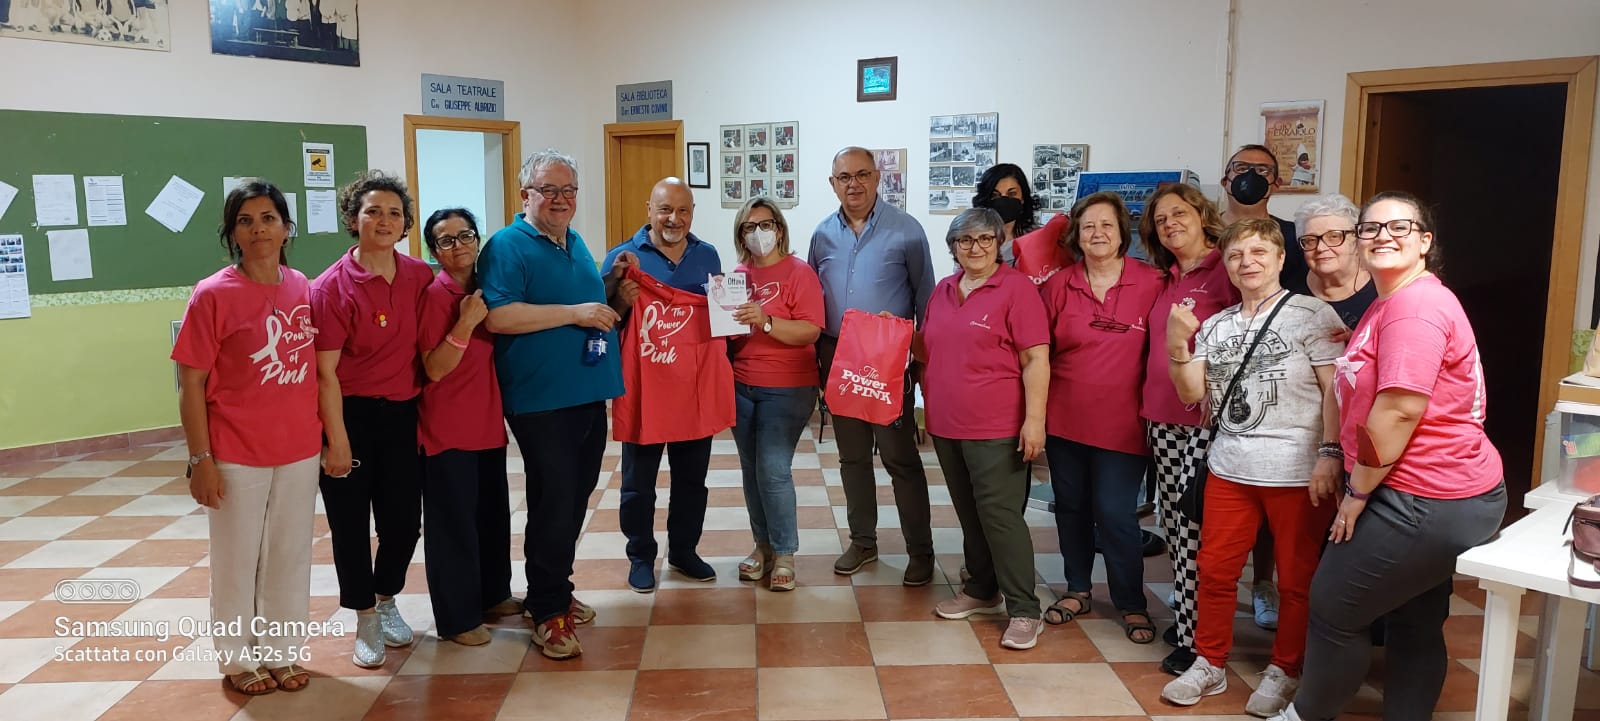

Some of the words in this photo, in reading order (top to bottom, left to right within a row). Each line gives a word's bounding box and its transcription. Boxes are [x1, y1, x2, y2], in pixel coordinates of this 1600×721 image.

[430, 82, 452, 94] SALA
[456, 84, 497, 98] TEATRALE
[620, 91, 635, 103] SALA
[636, 88, 668, 101] BIBLIOTECA
[444, 99, 472, 112] GIUSEPPE
[671, 307, 686, 318] The
[656, 319, 681, 331] Power
[661, 337, 669, 348] of
[289, 351, 300, 365] of
[640, 342, 679, 364] Pink
[260, 360, 309, 386] Pink
[841, 369, 888, 390] Power
[858, 365, 880, 380] The
[838, 381, 851, 396] of
[851, 383, 893, 405] PINK
